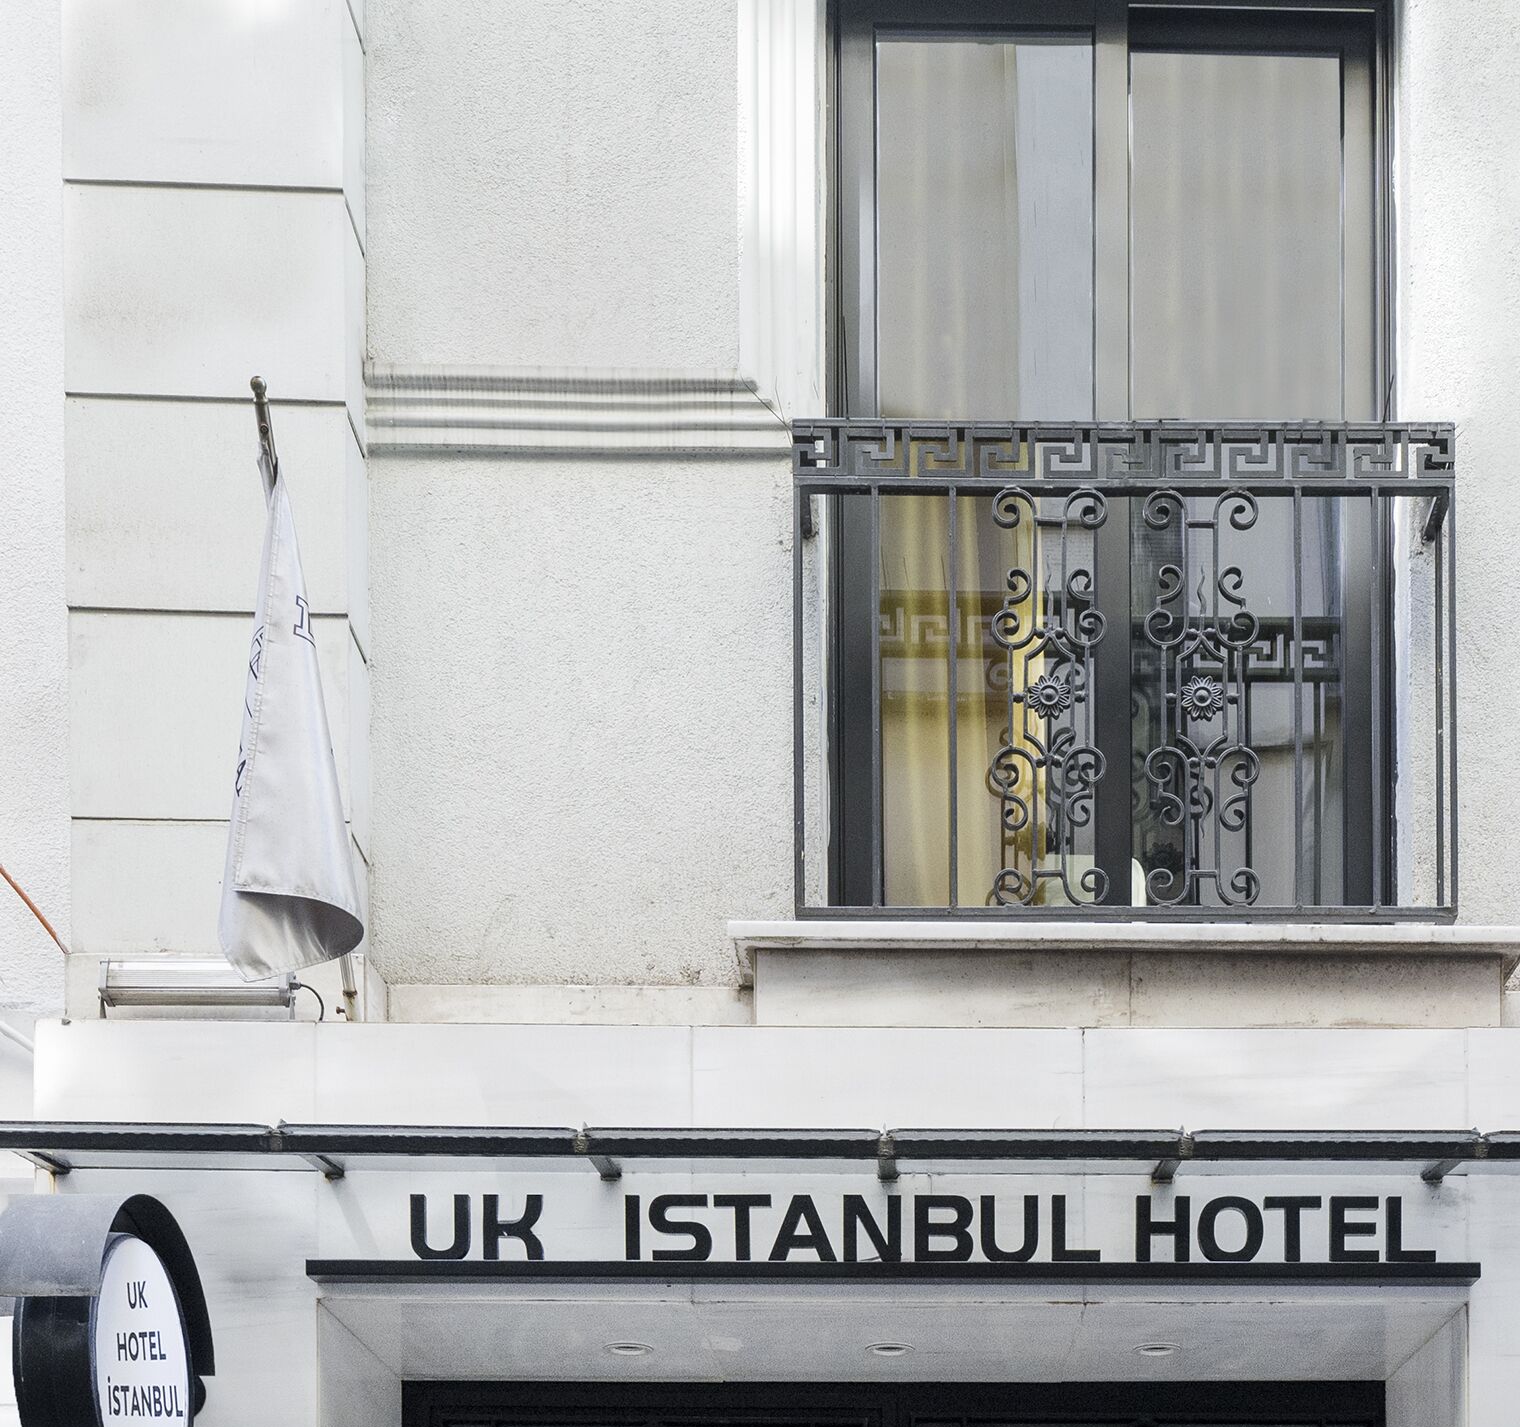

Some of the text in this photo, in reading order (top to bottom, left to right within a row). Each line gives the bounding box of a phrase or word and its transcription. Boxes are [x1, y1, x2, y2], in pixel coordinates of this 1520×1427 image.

[410, 1194, 1437, 1262] UK ISTANBUL HOTEL
[127, 1280, 148, 1309] UK
[116, 1331, 167, 1361] HOTEL
[107, 1376, 184, 1418] İSTANBUL
